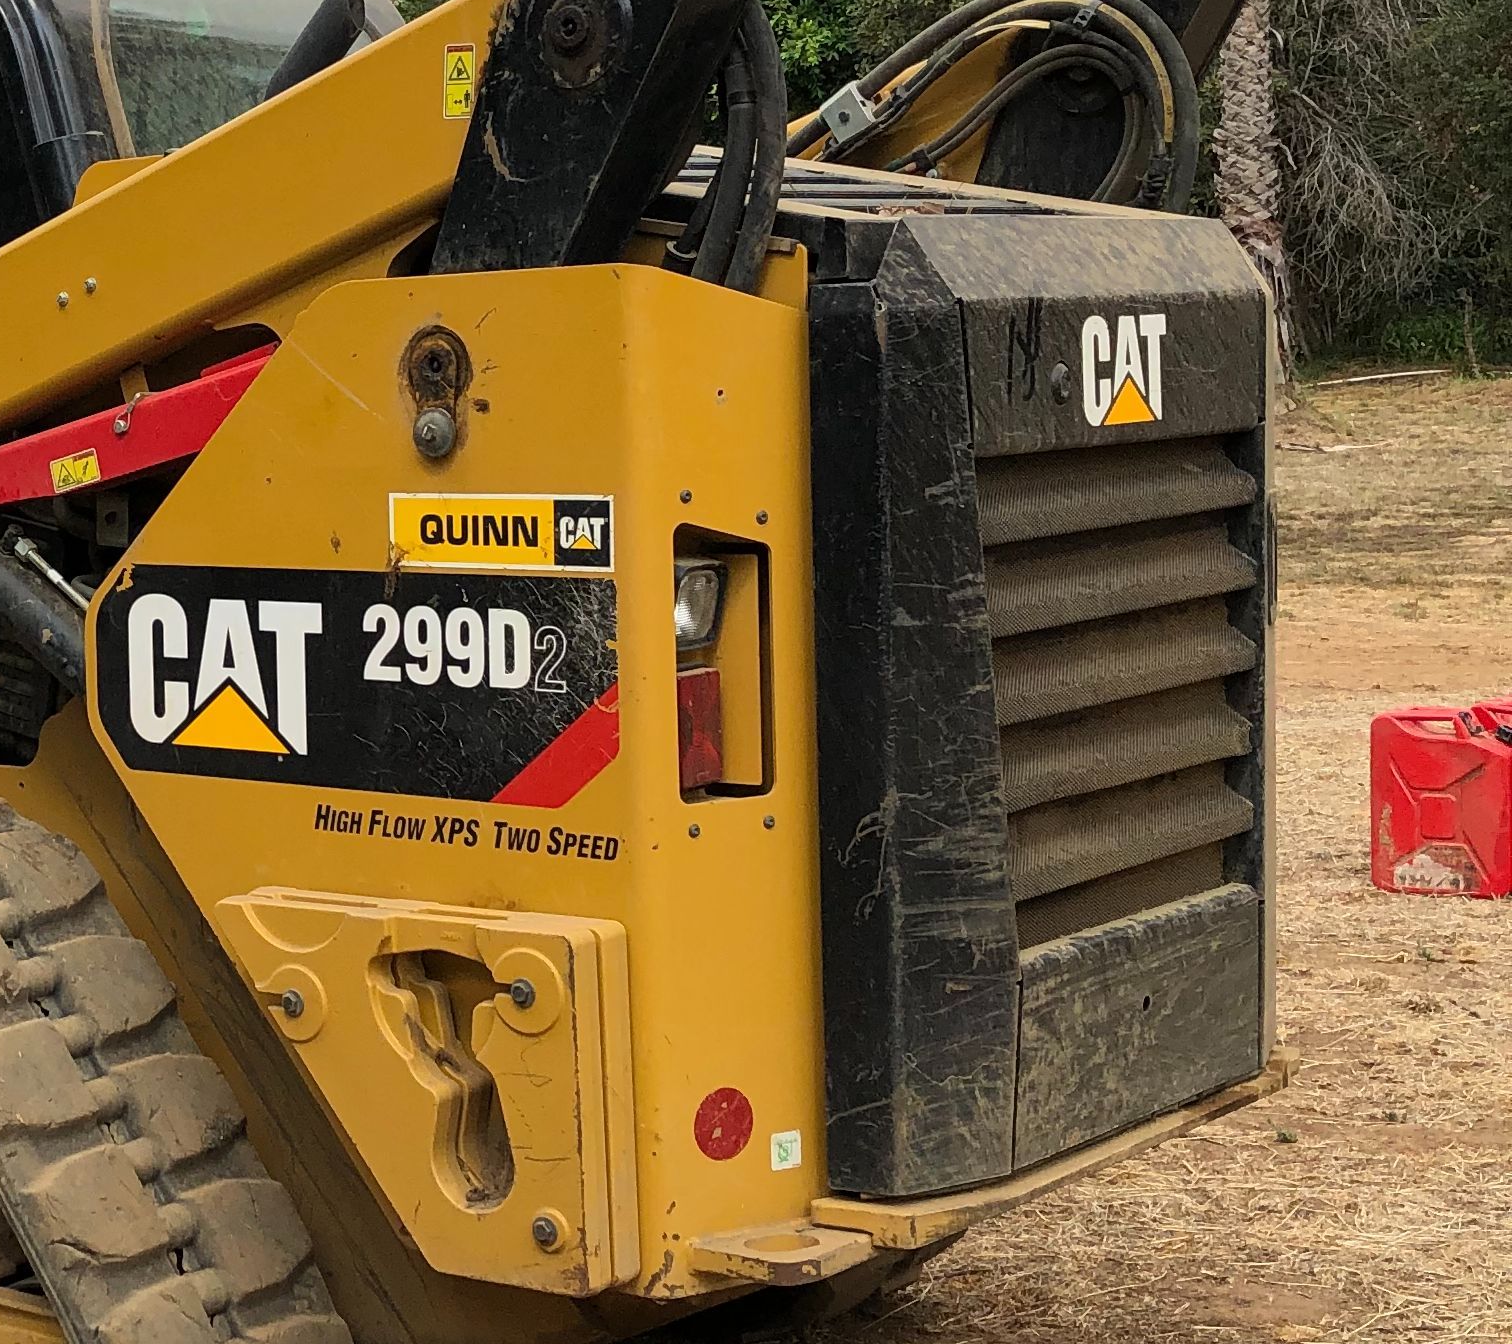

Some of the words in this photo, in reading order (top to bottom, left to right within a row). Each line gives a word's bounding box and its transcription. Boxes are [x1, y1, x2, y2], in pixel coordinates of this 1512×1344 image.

[1081, 313, 1167, 427] CAT
[419, 513, 539, 548] QUINN
[558, 516, 606, 550] CAT
[127, 593, 323, 756] CAT
[362, 602, 568, 694] 299D2
[430, 815, 481, 847] XPS
